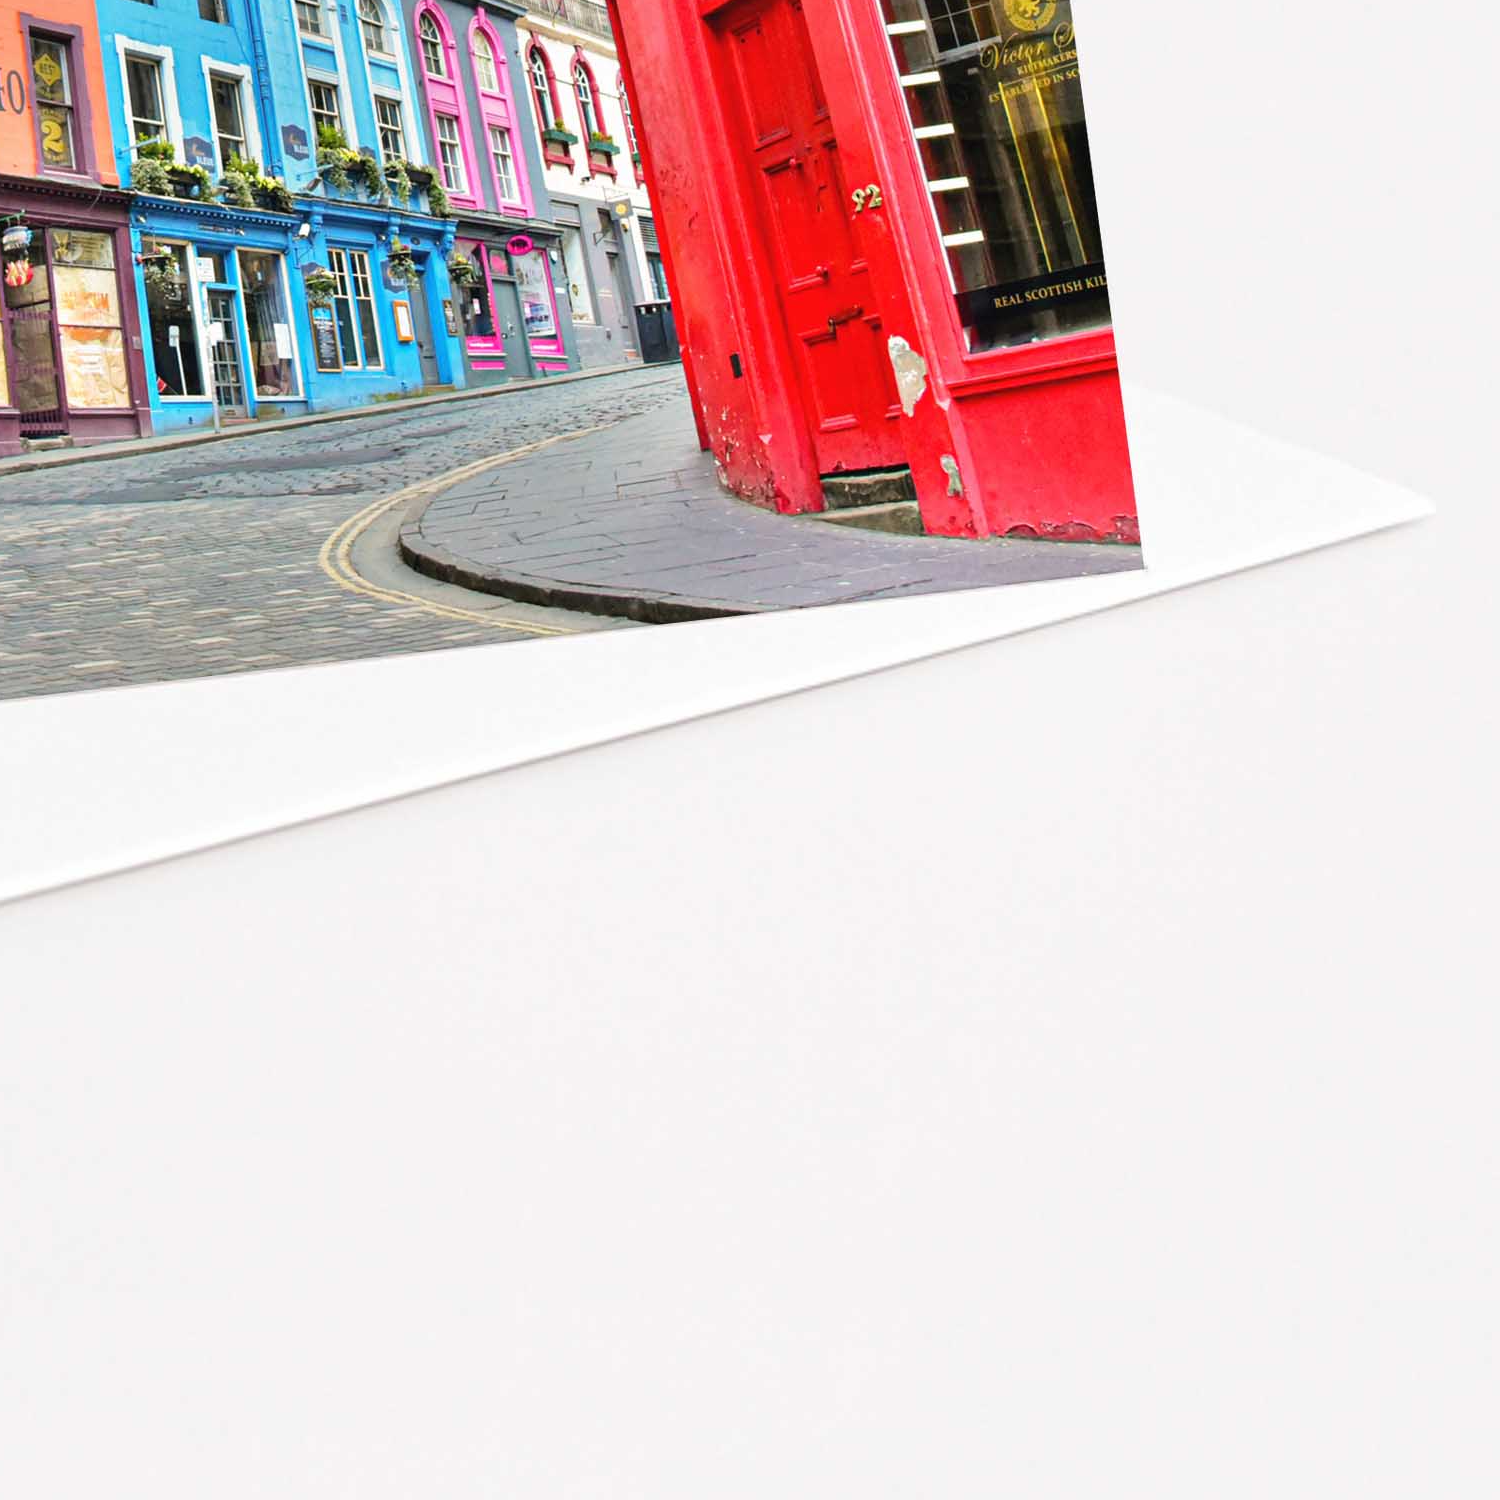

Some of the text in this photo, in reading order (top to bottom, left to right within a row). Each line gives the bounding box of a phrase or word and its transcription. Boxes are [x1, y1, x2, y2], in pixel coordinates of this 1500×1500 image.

[980, 32, 1046, 71] Victor
[41, 120, 65, 154] 2
[851, 183, 883, 213] 92
[993, 274, 1107, 309] REAL SCOTTISH KIL
